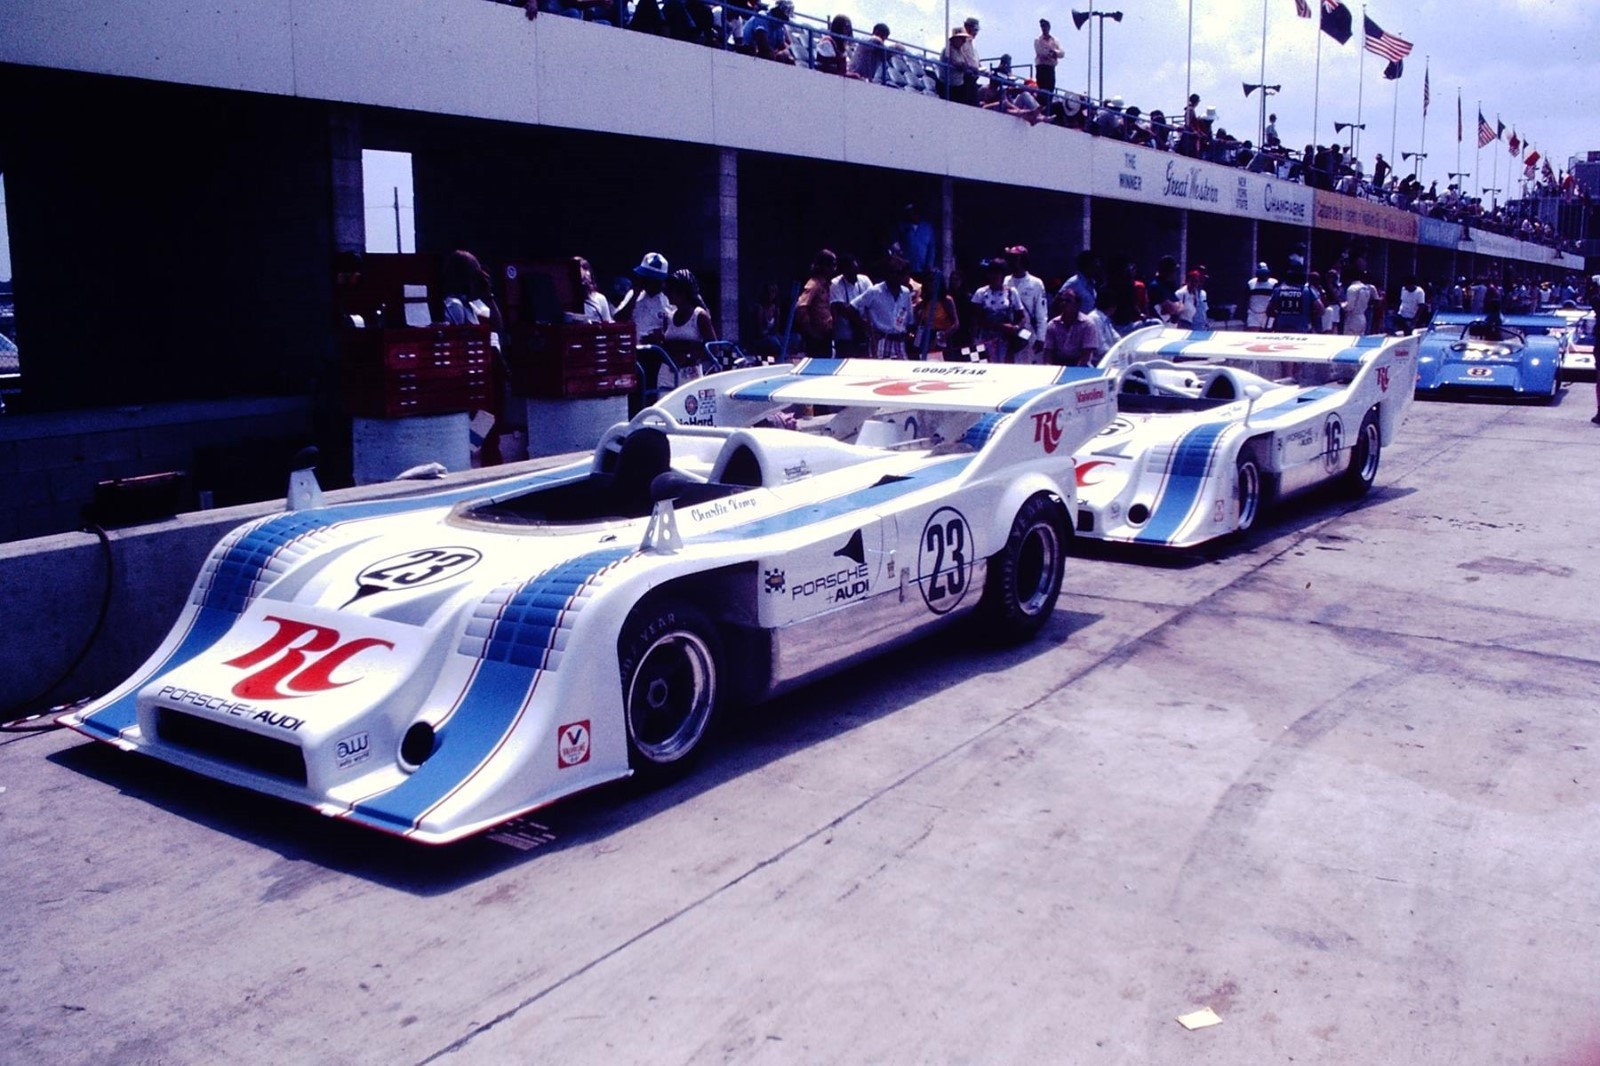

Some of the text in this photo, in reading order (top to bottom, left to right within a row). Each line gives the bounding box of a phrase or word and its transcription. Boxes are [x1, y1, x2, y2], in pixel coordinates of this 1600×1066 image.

[1124, 152, 1136, 170] THE
[1119, 173, 1142, 191] WINNER
[1163, 160, 1219, 203] Great Western
[1264, 183, 1305, 217] CHAMPAGNE
[911, 366, 988, 377] GOODYEAR
[1075, 388, 1105, 404] Valvoline
[1030, 407, 1064, 455] RC
[1325, 420, 1341, 466] 16
[691, 503, 728, 522] Charlie
[364, 549, 475, 586] 23
[926, 518, 965, 602] 23
[791, 562, 869, 600] PORSCHE
[221, 615, 395, 700] RC
